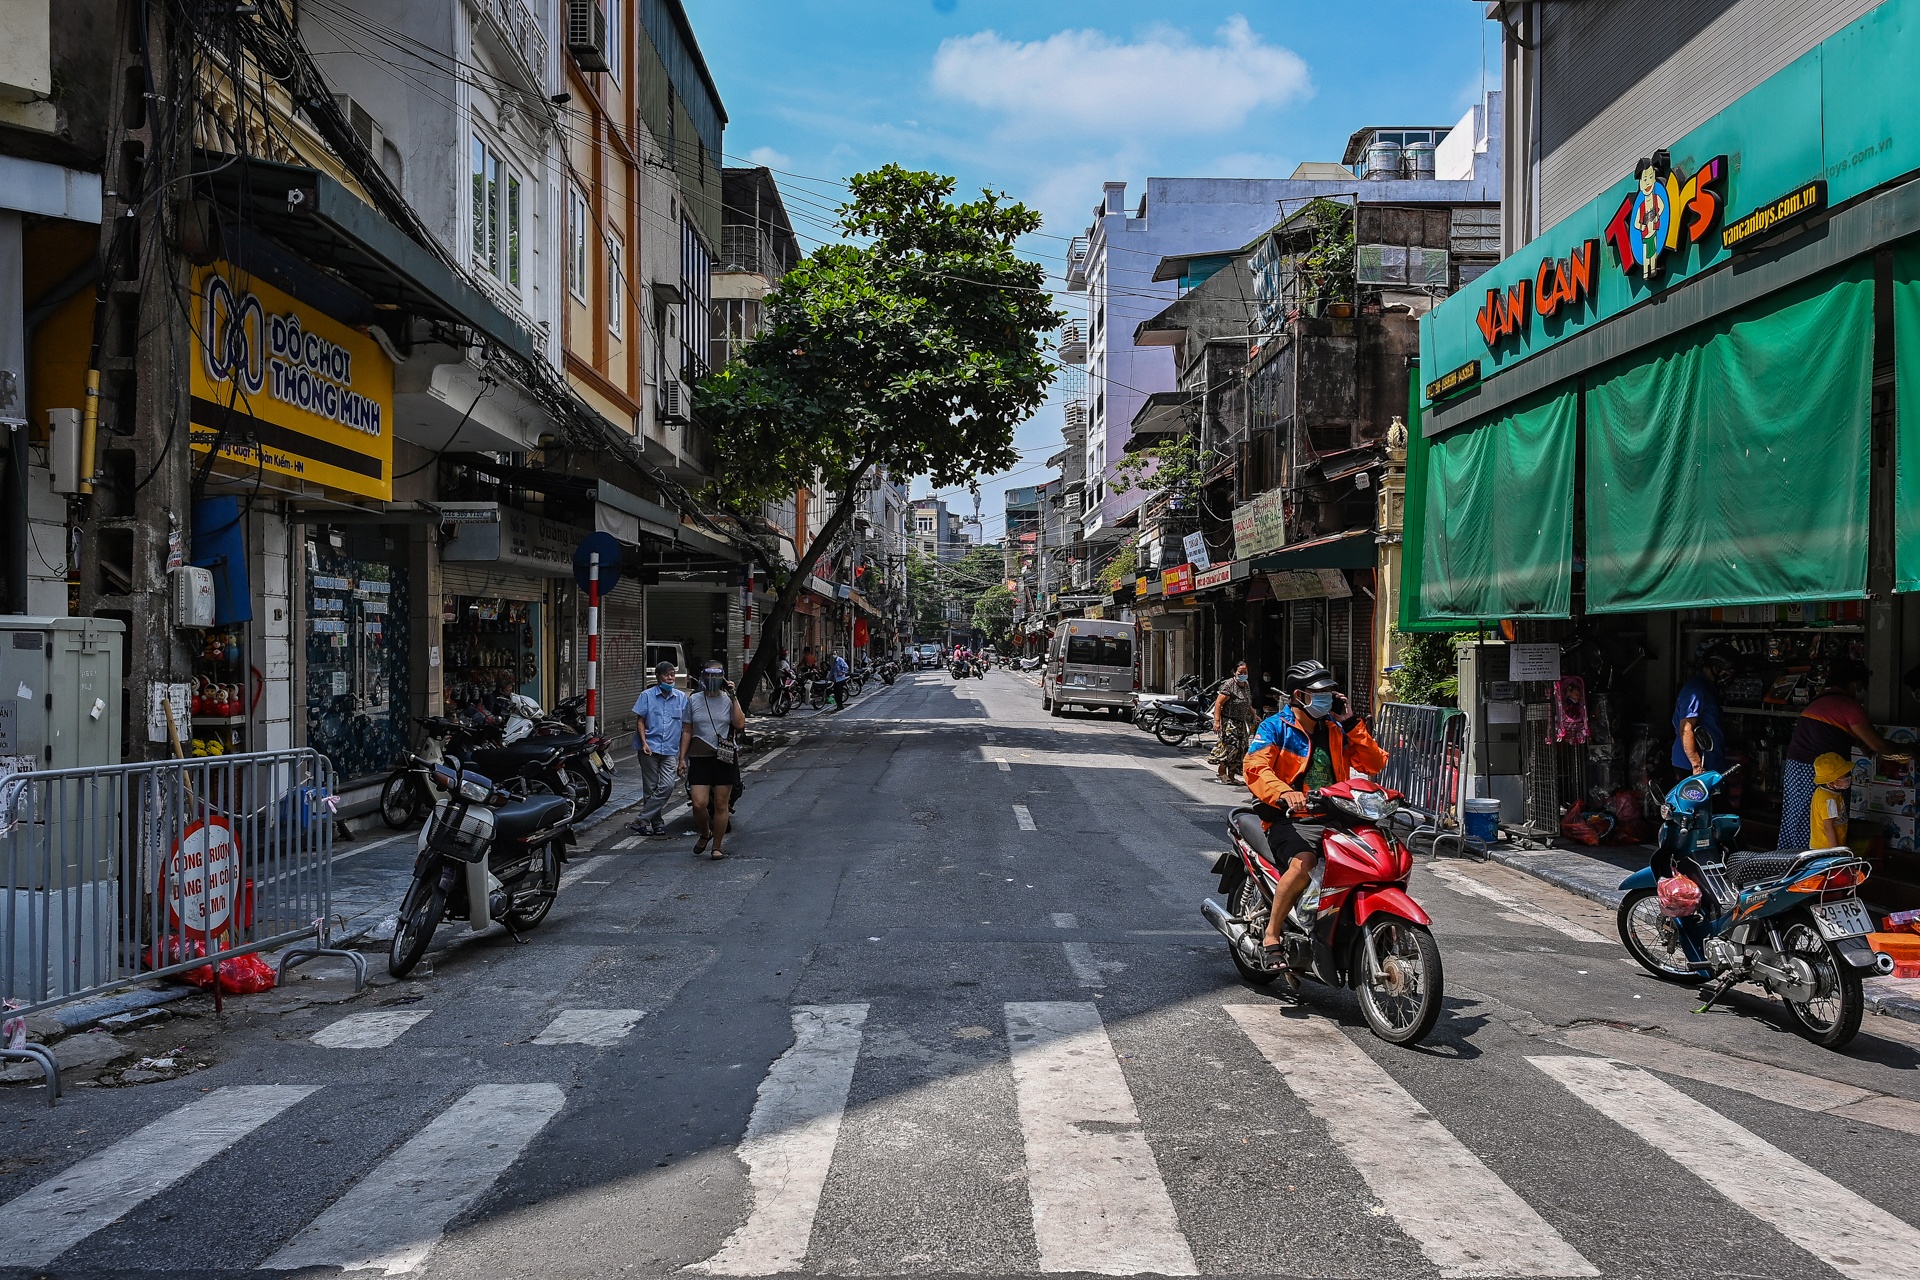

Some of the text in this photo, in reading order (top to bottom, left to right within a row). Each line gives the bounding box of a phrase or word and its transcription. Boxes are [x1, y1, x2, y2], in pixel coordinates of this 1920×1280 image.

[1722, 185, 1817, 247] vancantoys.com.vn
[1475, 280, 1529, 346] VAN
[1535, 240, 1596, 317] CAN
[270, 313, 351, 387] ĐỒ CHƠI
[270, 360, 382, 437] THÔNG MINH
[274, 454, 291, 469] Kiếm
[294, 460, 304, 473] HN
[206, 872, 218, 890] HI
[219, 864, 238, 886] CÔG
